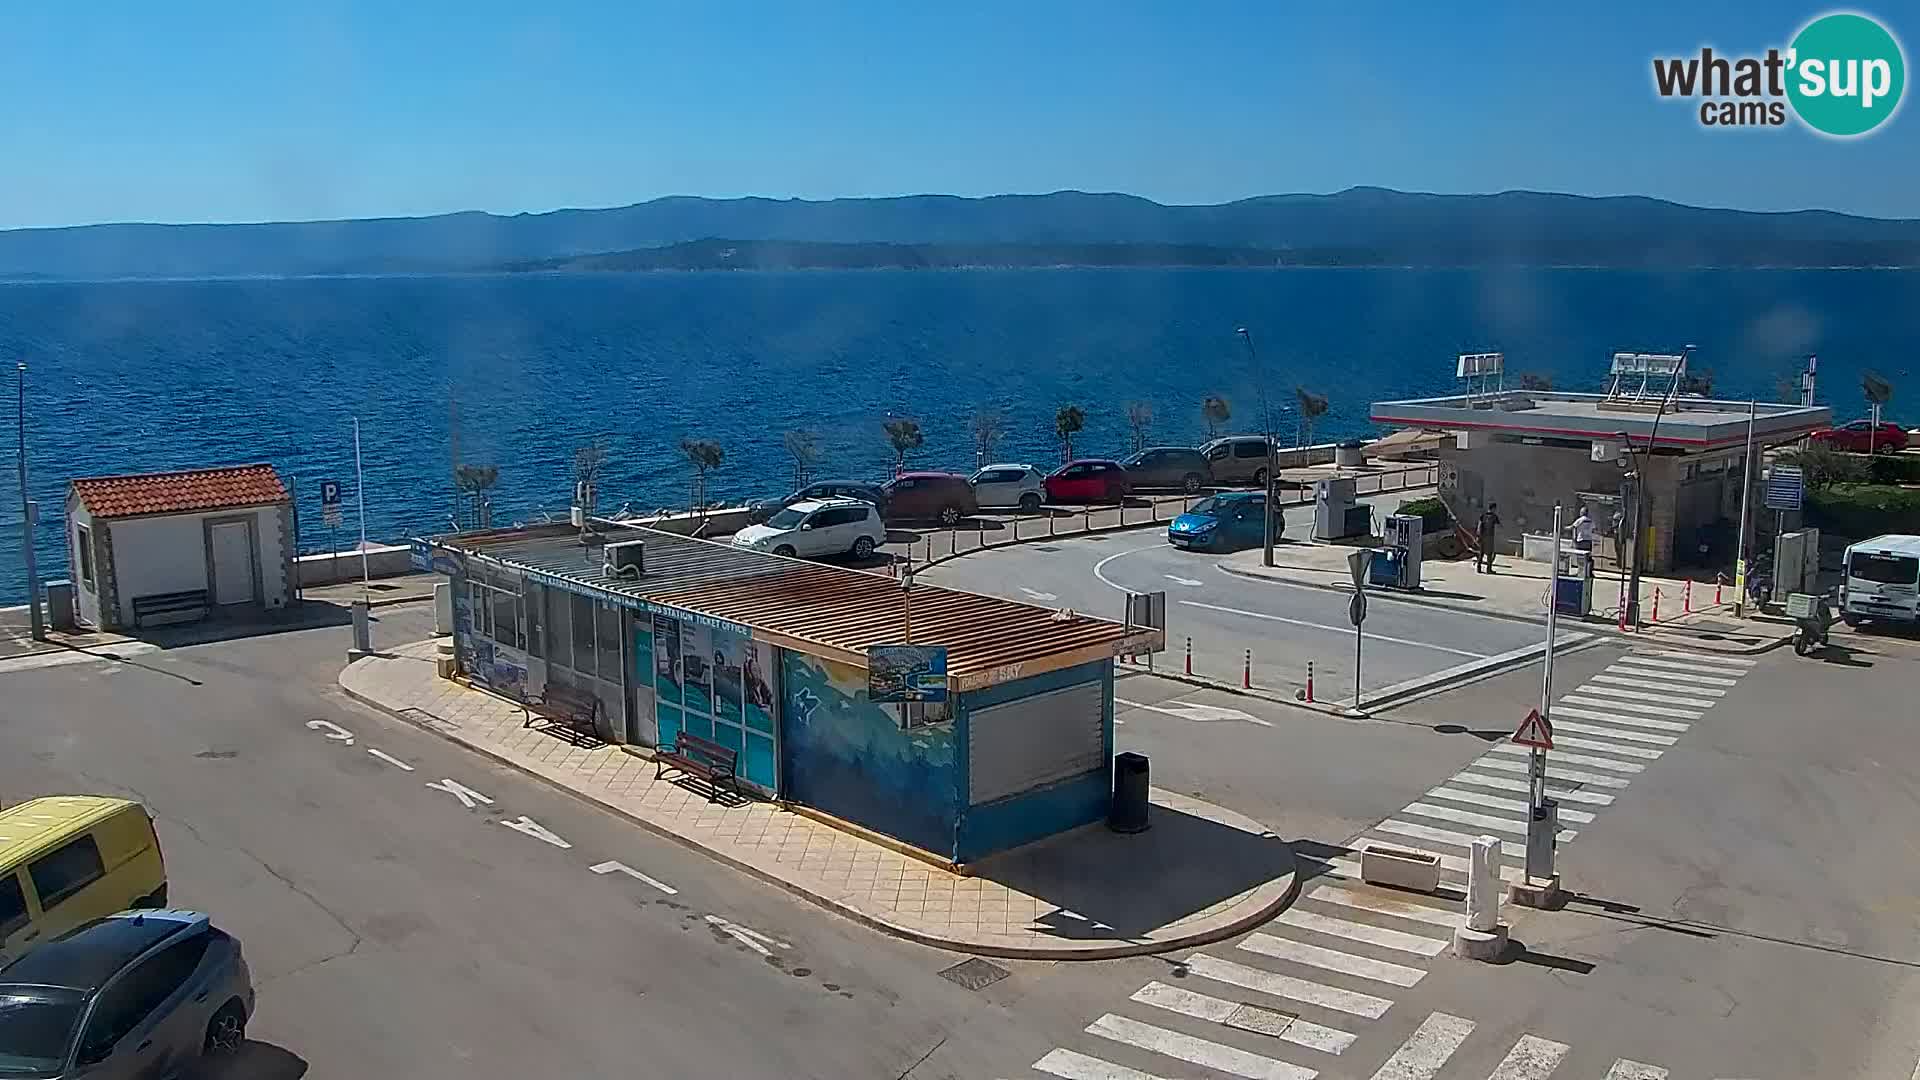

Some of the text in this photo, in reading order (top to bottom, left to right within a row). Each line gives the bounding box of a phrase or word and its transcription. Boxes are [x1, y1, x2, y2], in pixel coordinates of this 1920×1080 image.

[325, 484, 337, 501] P
[648, 603, 662, 615] BUS
[663, 606, 694, 622] STATION
[696, 614, 721, 629] TICKET
[721, 620, 747, 635] OFFICE
